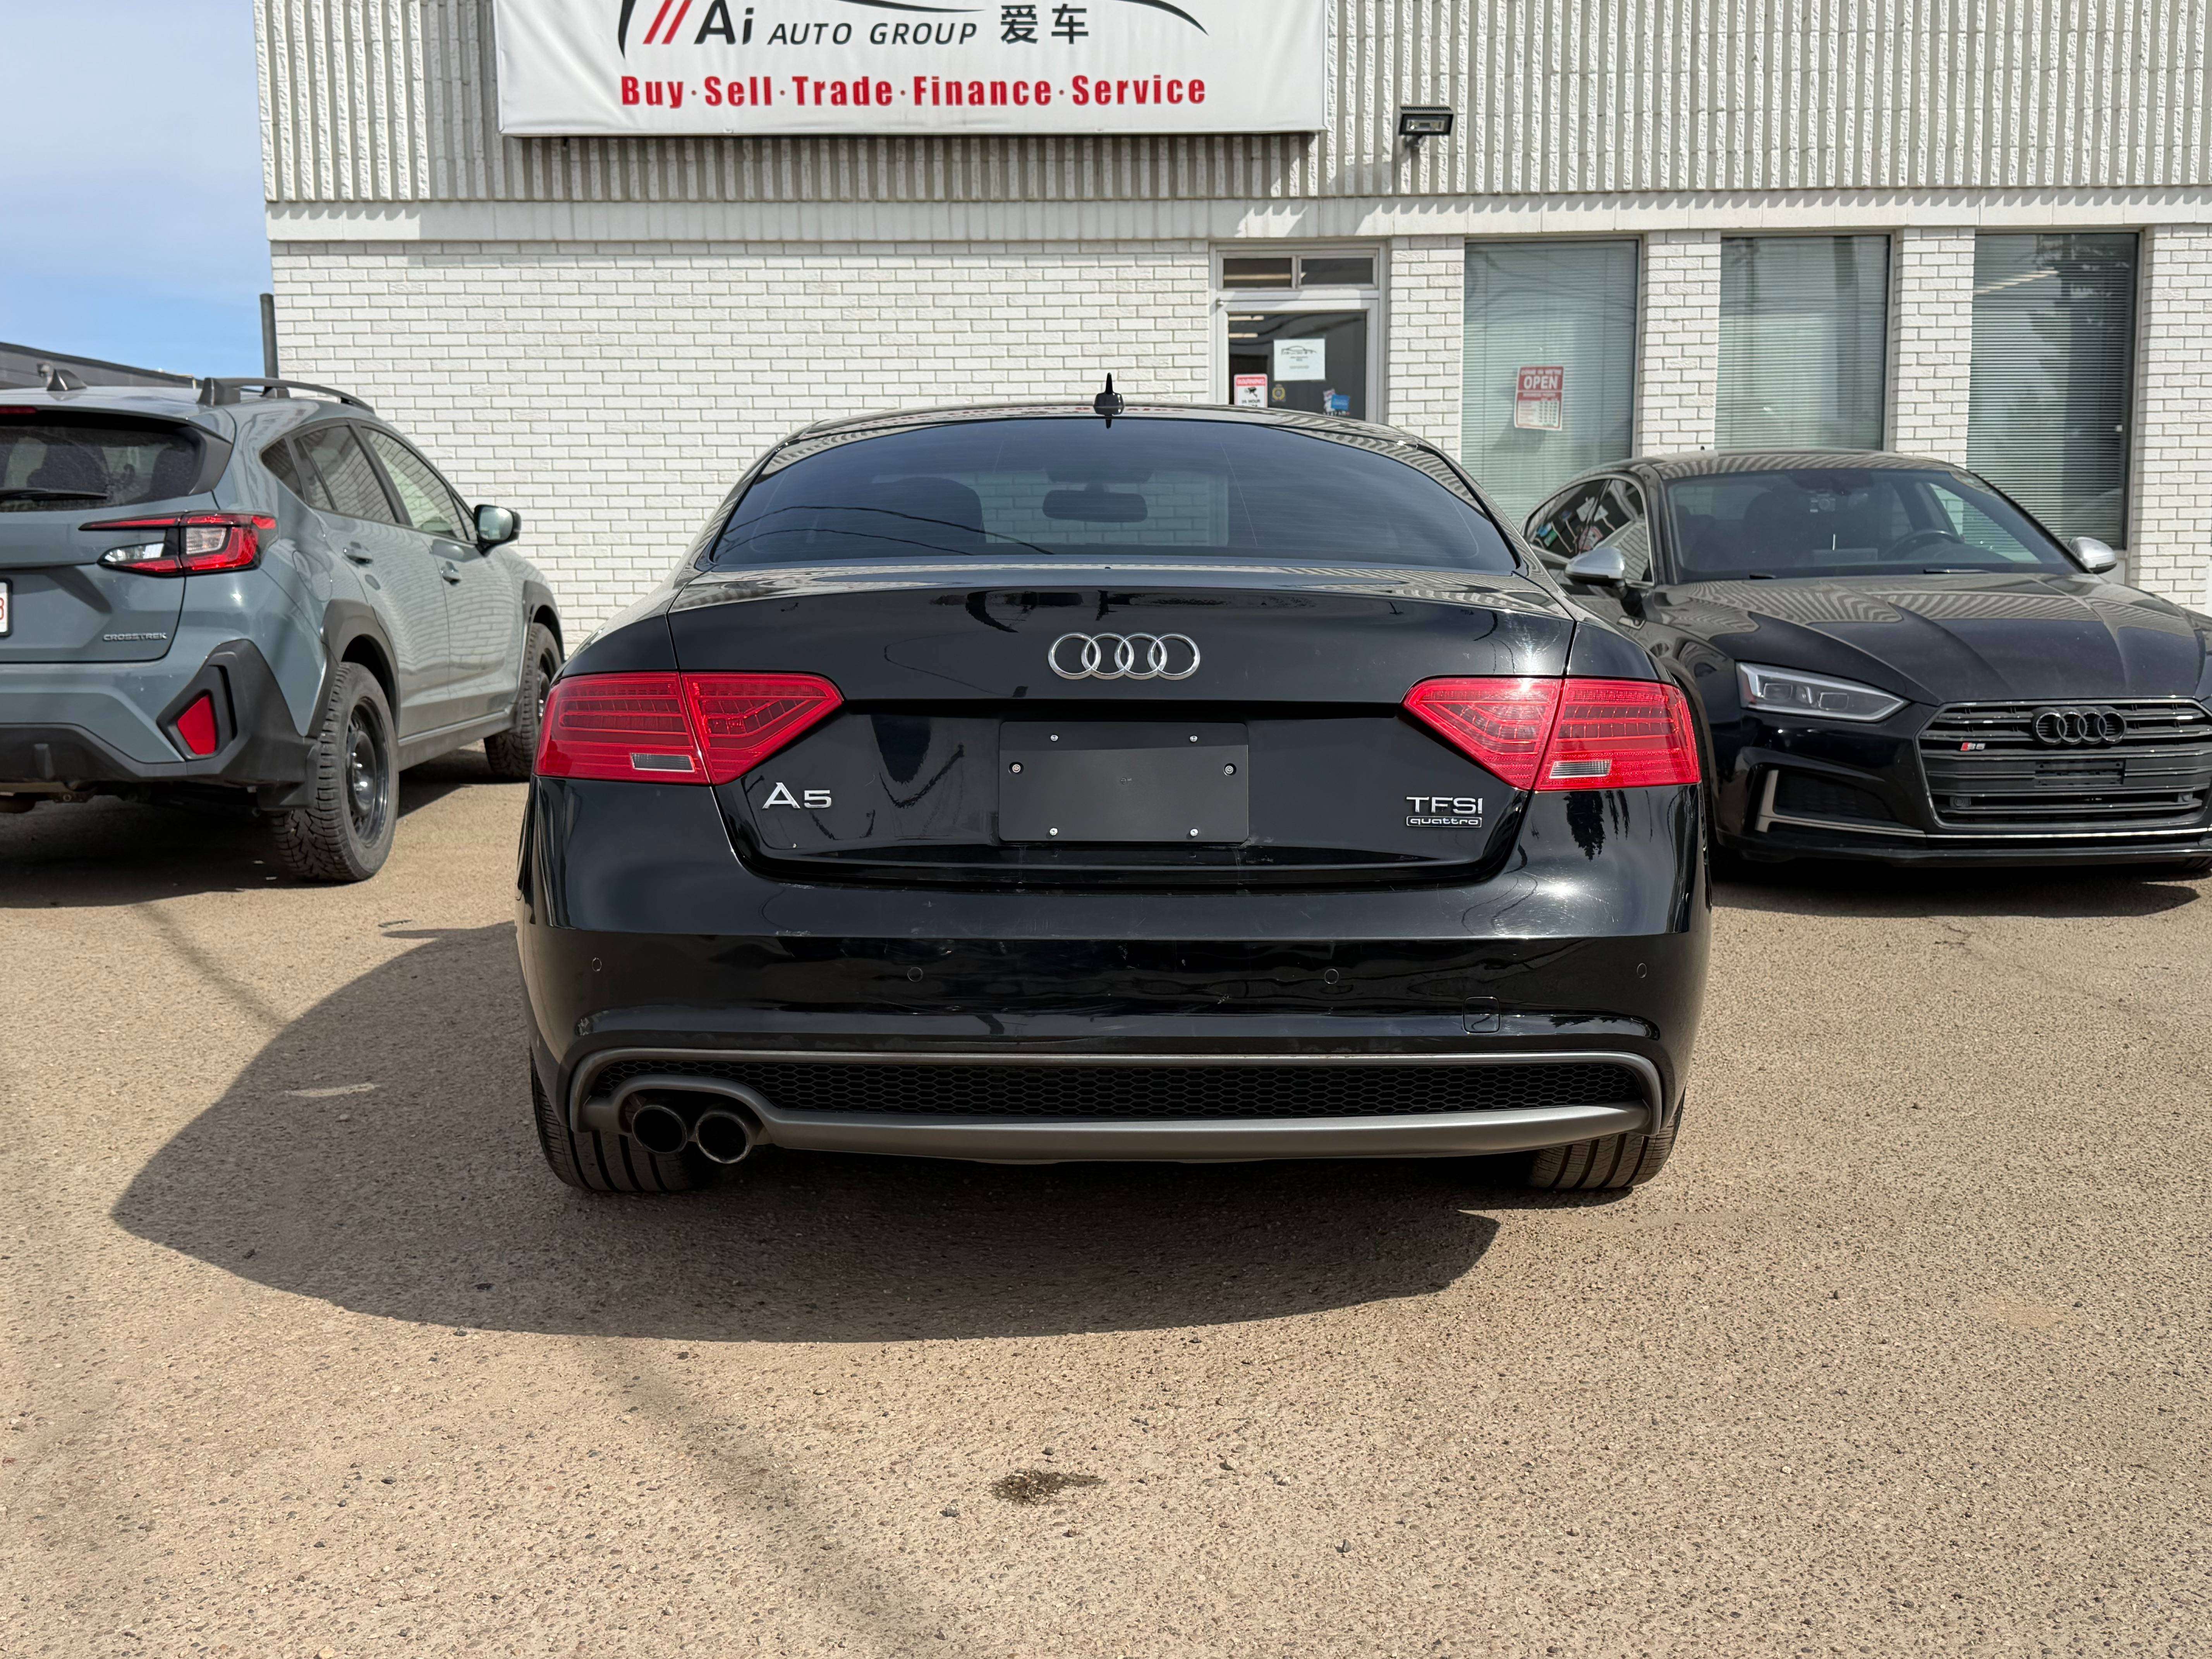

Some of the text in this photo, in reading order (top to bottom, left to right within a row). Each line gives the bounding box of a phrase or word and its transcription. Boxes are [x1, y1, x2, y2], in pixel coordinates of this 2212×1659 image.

[767, 23, 852, 45] AUTO
[869, 22, 977, 45] GROUP
[1001, 3, 1089, 45] 爱车
[621, 75, 1206, 108] Buy Sell Trade Finance Service
[1523, 375, 1558, 389] OPEN
[103, 632, 167, 641] CROSSTREK
[762, 782, 831, 809] A5
[1406, 797, 1483, 814] TFSI
